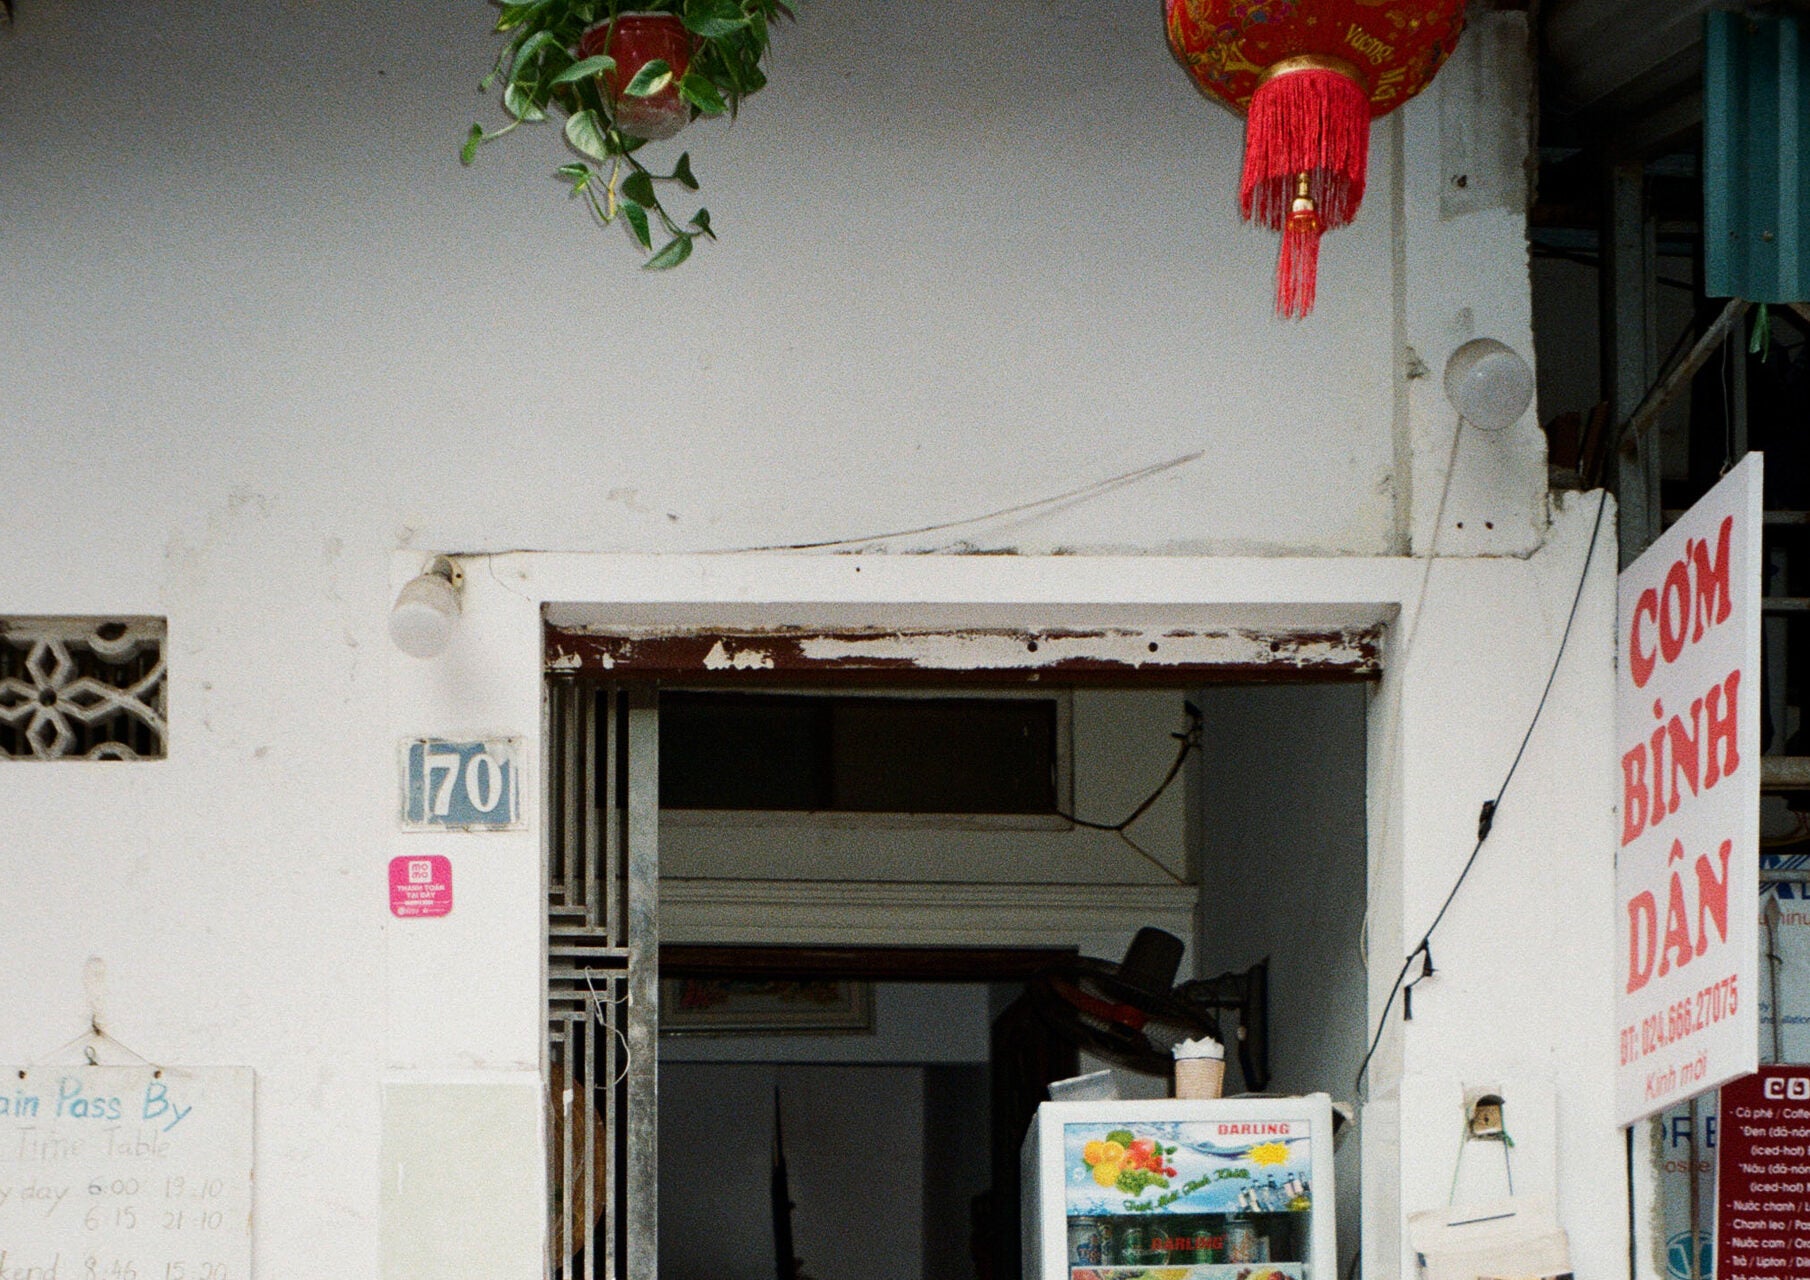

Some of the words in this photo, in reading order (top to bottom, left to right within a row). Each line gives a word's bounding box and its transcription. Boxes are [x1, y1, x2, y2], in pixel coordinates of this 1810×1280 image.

[1629, 515, 1733, 689] CƠM
[424, 753, 502, 815] 70
[1627, 838, 1732, 994] DÂN
[57, 1077, 122, 1120] Pass
[143, 1080, 192, 1132] By
[1218, 1123, 1290, 1136] DARLING
[102, 1126, 171, 1158] Table
[1751, 1145, 1805, 1157] (iced-hot)
[1750, 1182, 1804, 1194] (iced-hot)
[21, 1177, 69, 1218] day
[1763, 1201, 1795, 1212] chanh
[1732, 1218, 1767, 1230] Chanh
[1152, 1235, 1223, 1250] DARLING
[1761, 1239, 1785, 1249] cam
